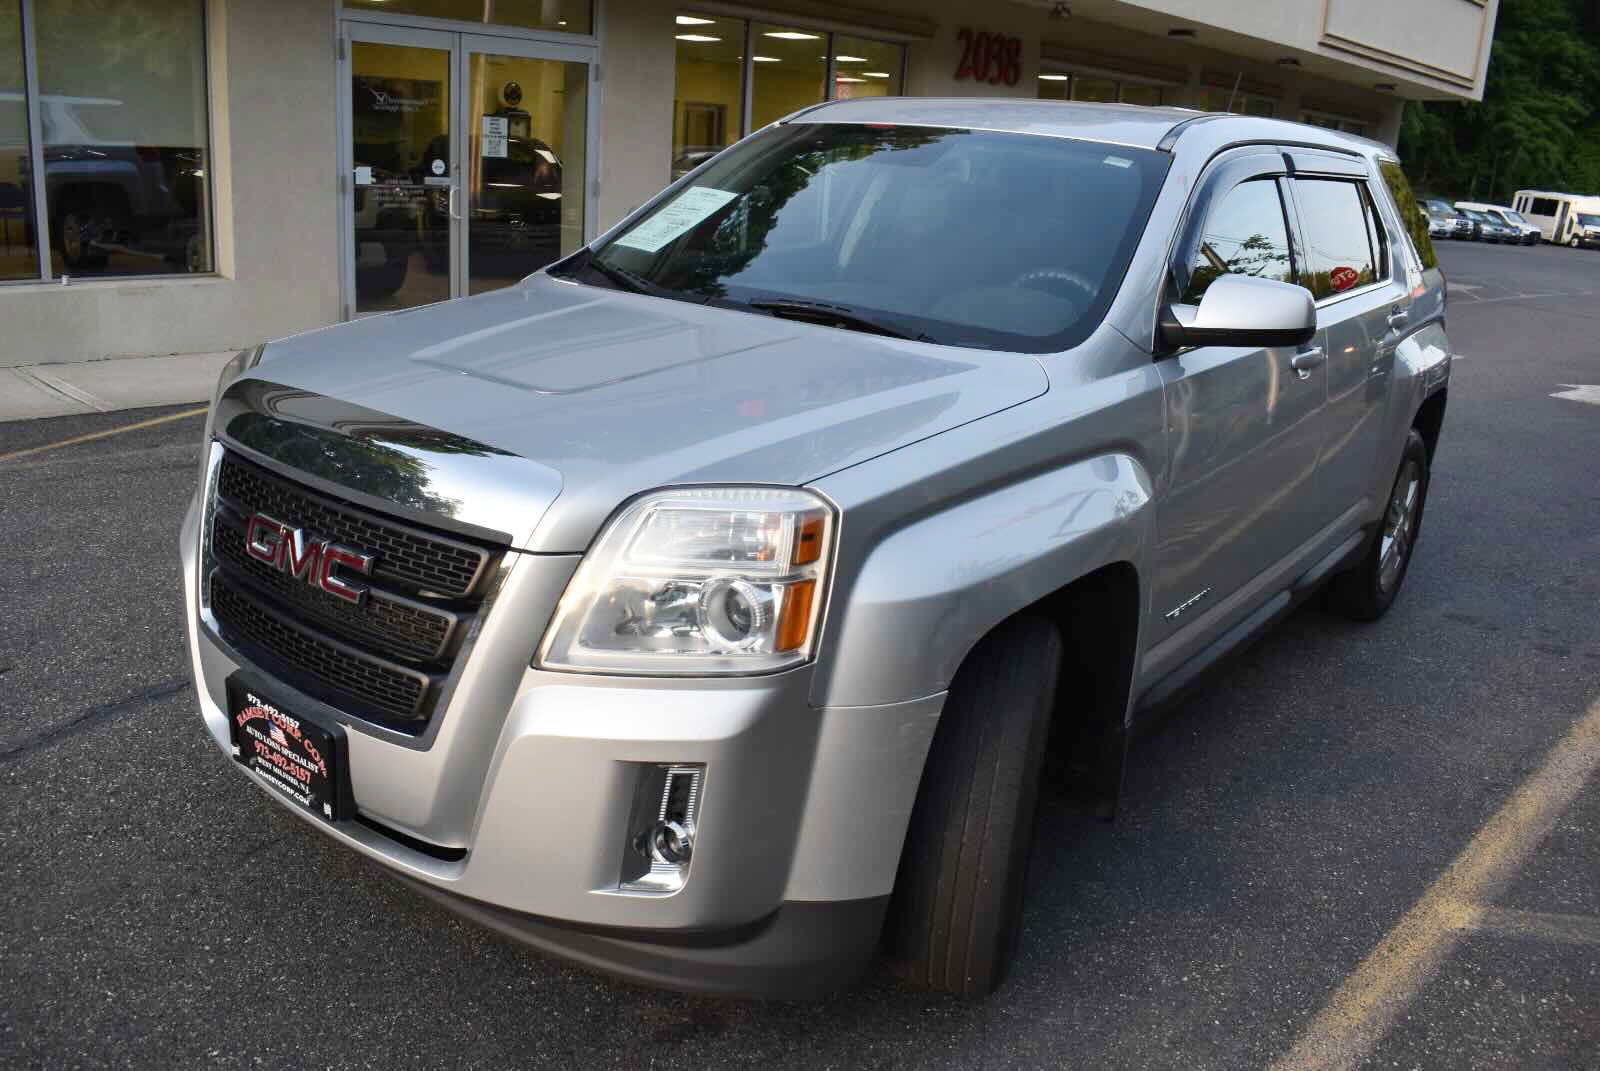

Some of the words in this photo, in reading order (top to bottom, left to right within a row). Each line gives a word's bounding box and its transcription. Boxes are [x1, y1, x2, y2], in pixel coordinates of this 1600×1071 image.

[246, 512, 374, 604] GMC
[255, 740, 311, 785] 973-492-5157
[263, 735, 281, 752] LOAN
[281, 746, 318, 773] SPECIALIST
